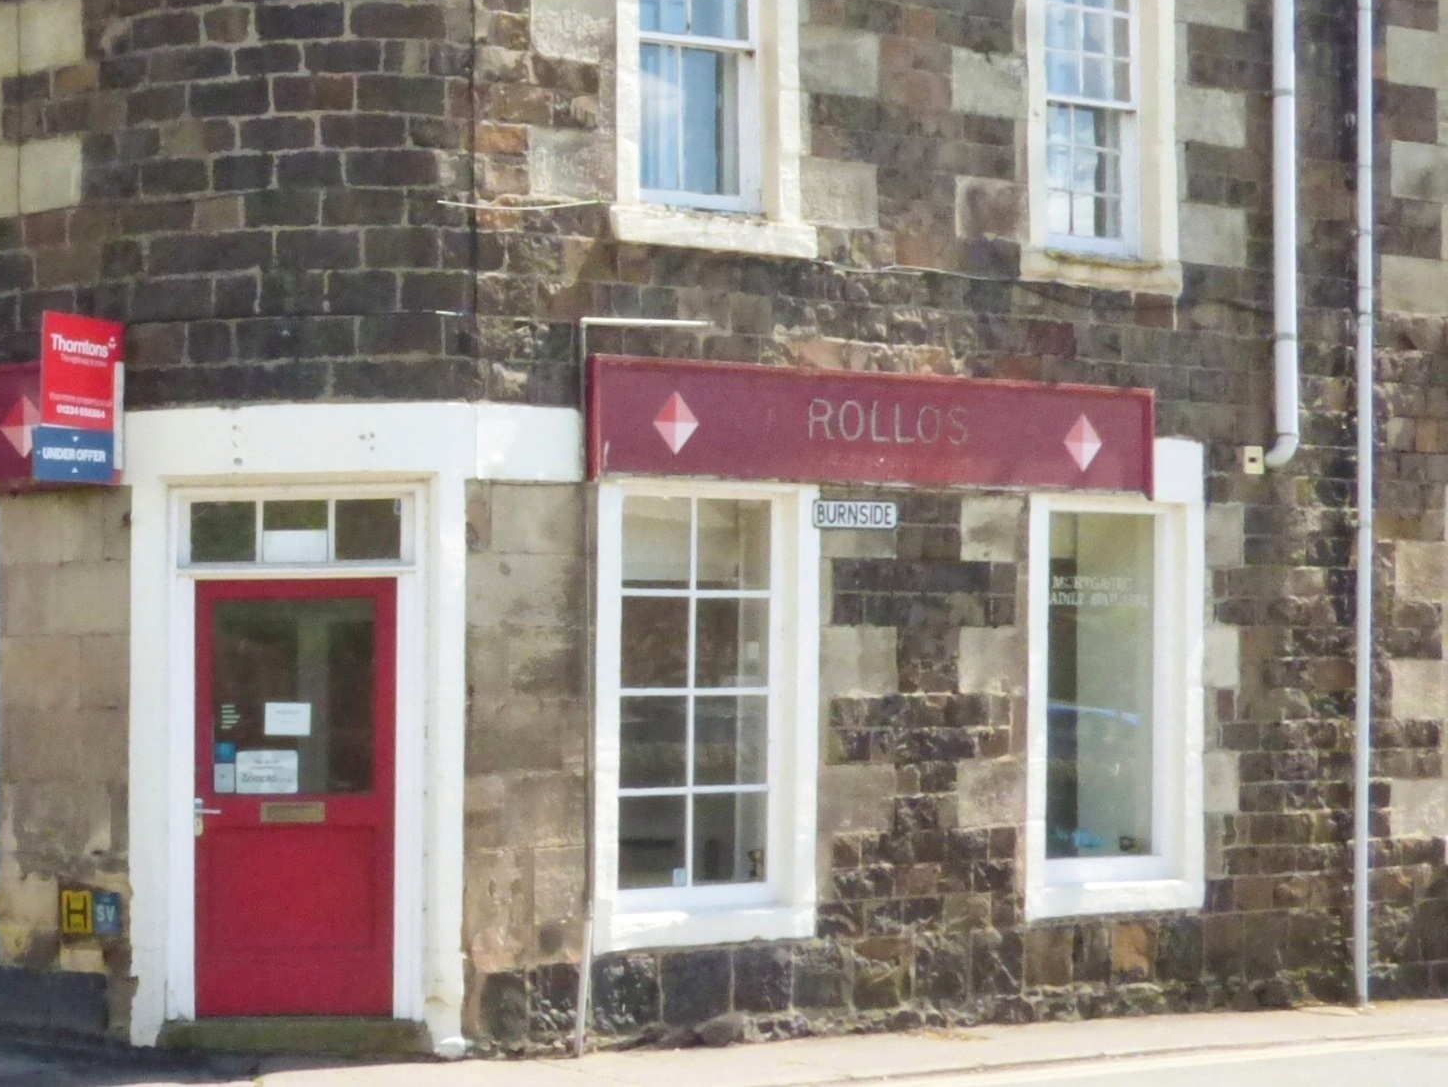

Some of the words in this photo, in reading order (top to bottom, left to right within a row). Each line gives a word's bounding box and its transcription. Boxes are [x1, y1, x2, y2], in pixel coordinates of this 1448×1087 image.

[51, 333, 109, 358] Thorntons
[808, 398, 969, 445] ROLLOS
[42, 447, 75, 461] UNDER
[76, 449, 106, 463] OFFER
[817, 504, 892, 525] BURNSIDE
[66, 895, 88, 929] H
[96, 905, 116, 922] SV
